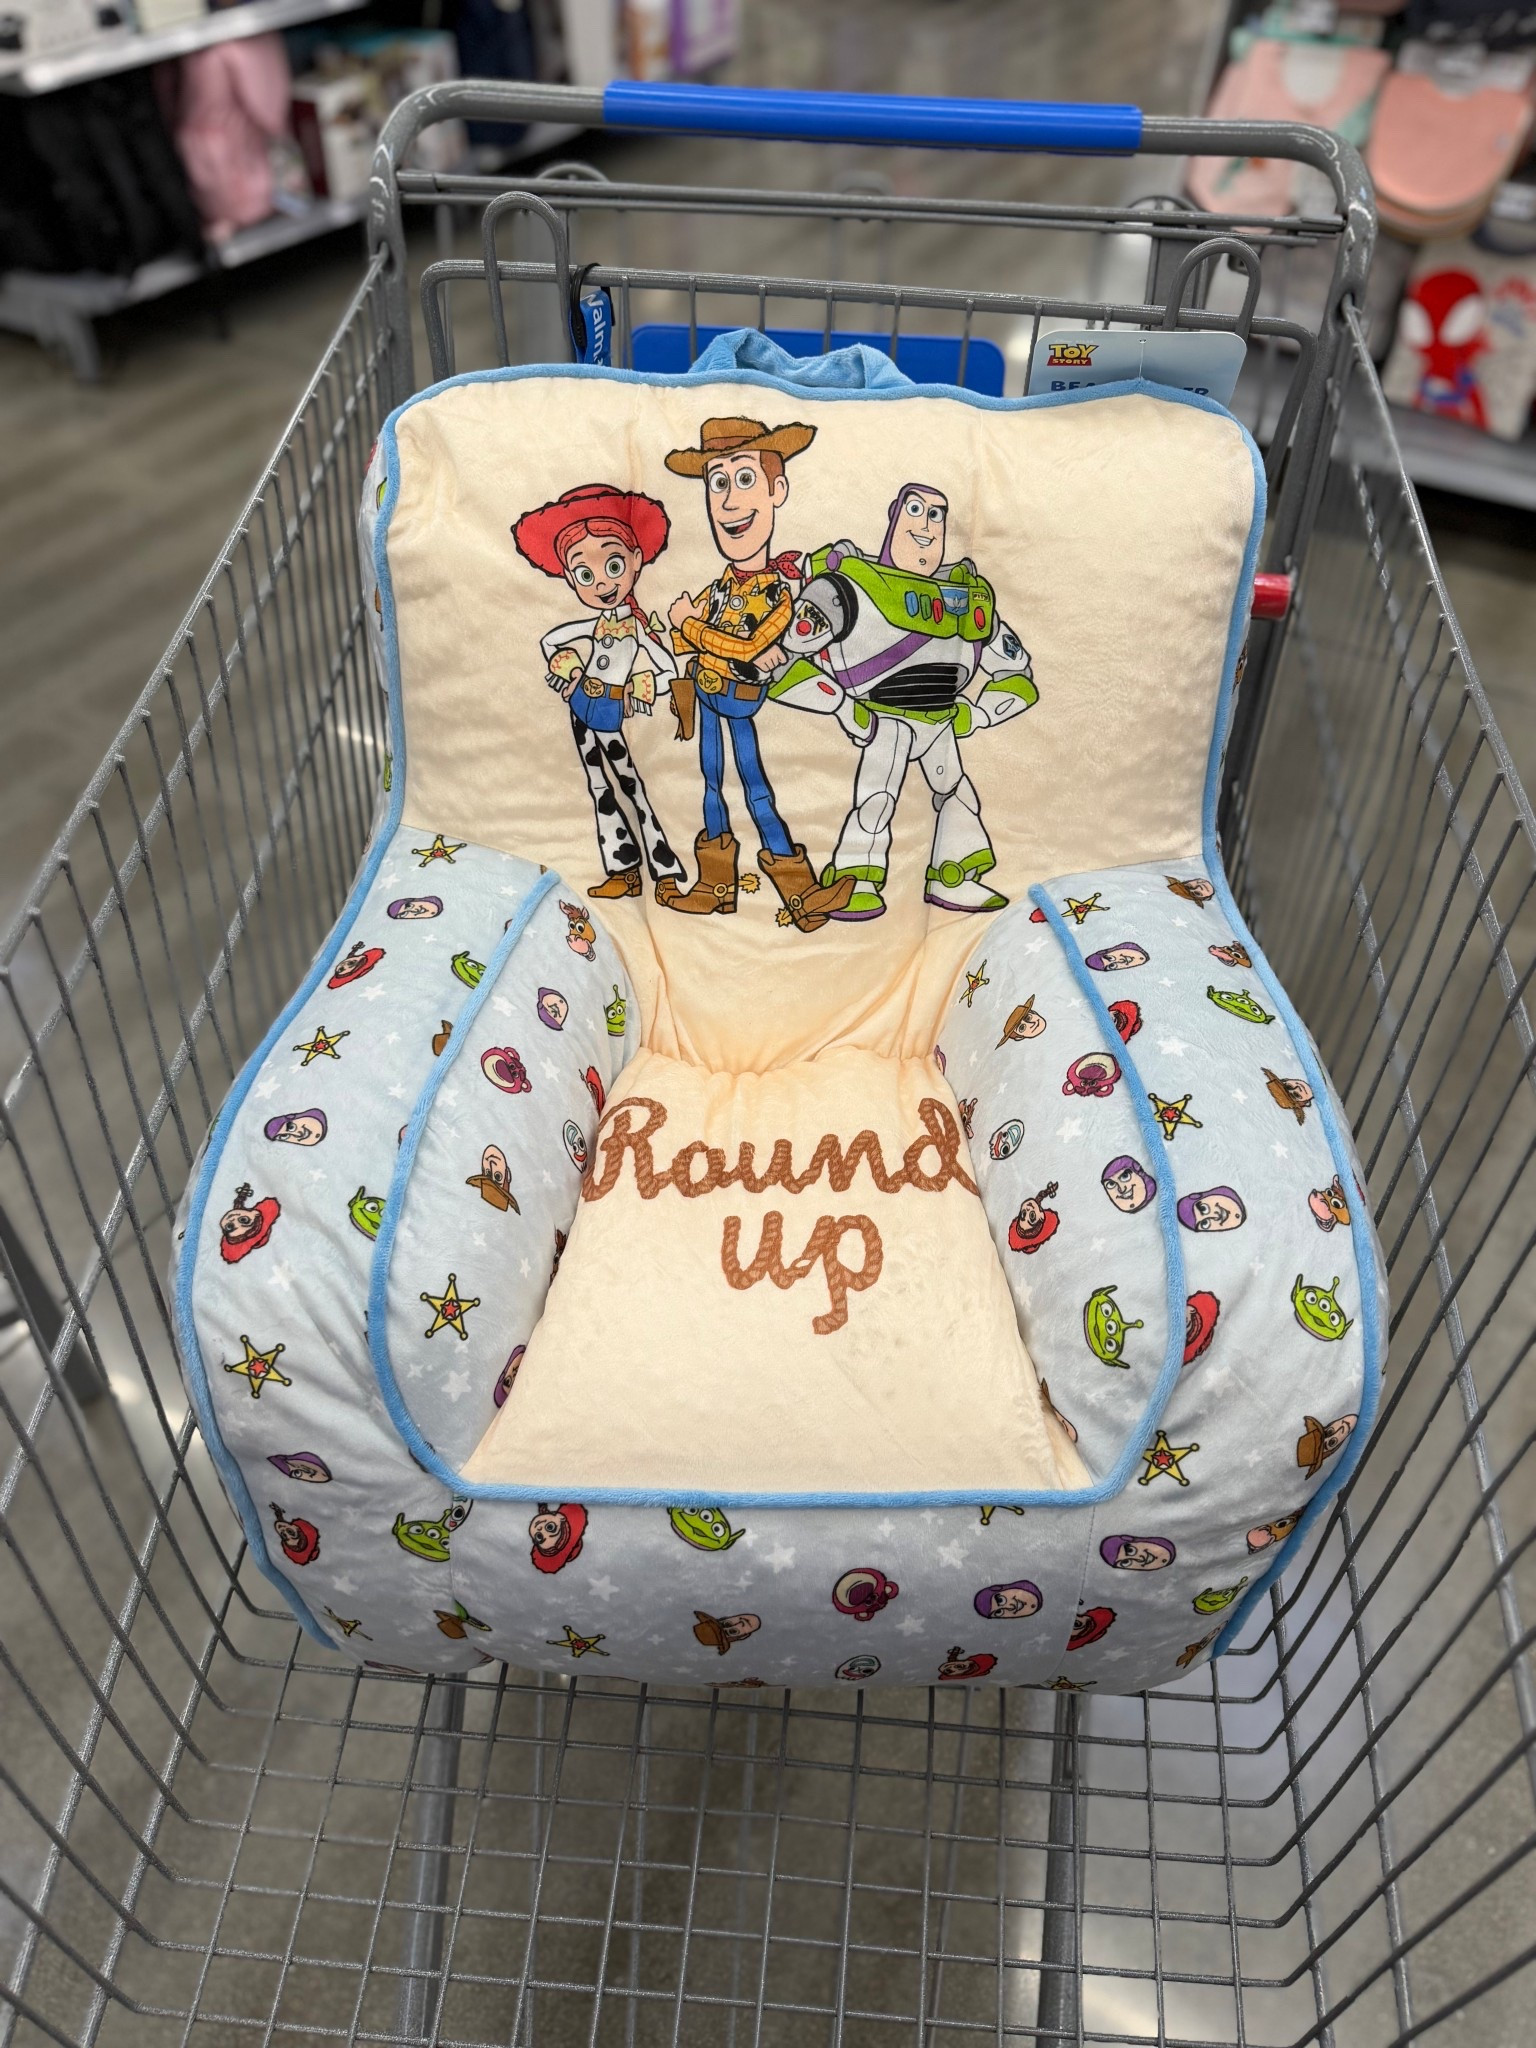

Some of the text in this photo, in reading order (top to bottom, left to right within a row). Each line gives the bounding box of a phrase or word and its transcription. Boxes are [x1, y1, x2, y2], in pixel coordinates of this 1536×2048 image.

[1049, 344, 1099, 359] TOY
[582, 1097, 979, 1201] Round
[721, 1210, 884, 1335] up
